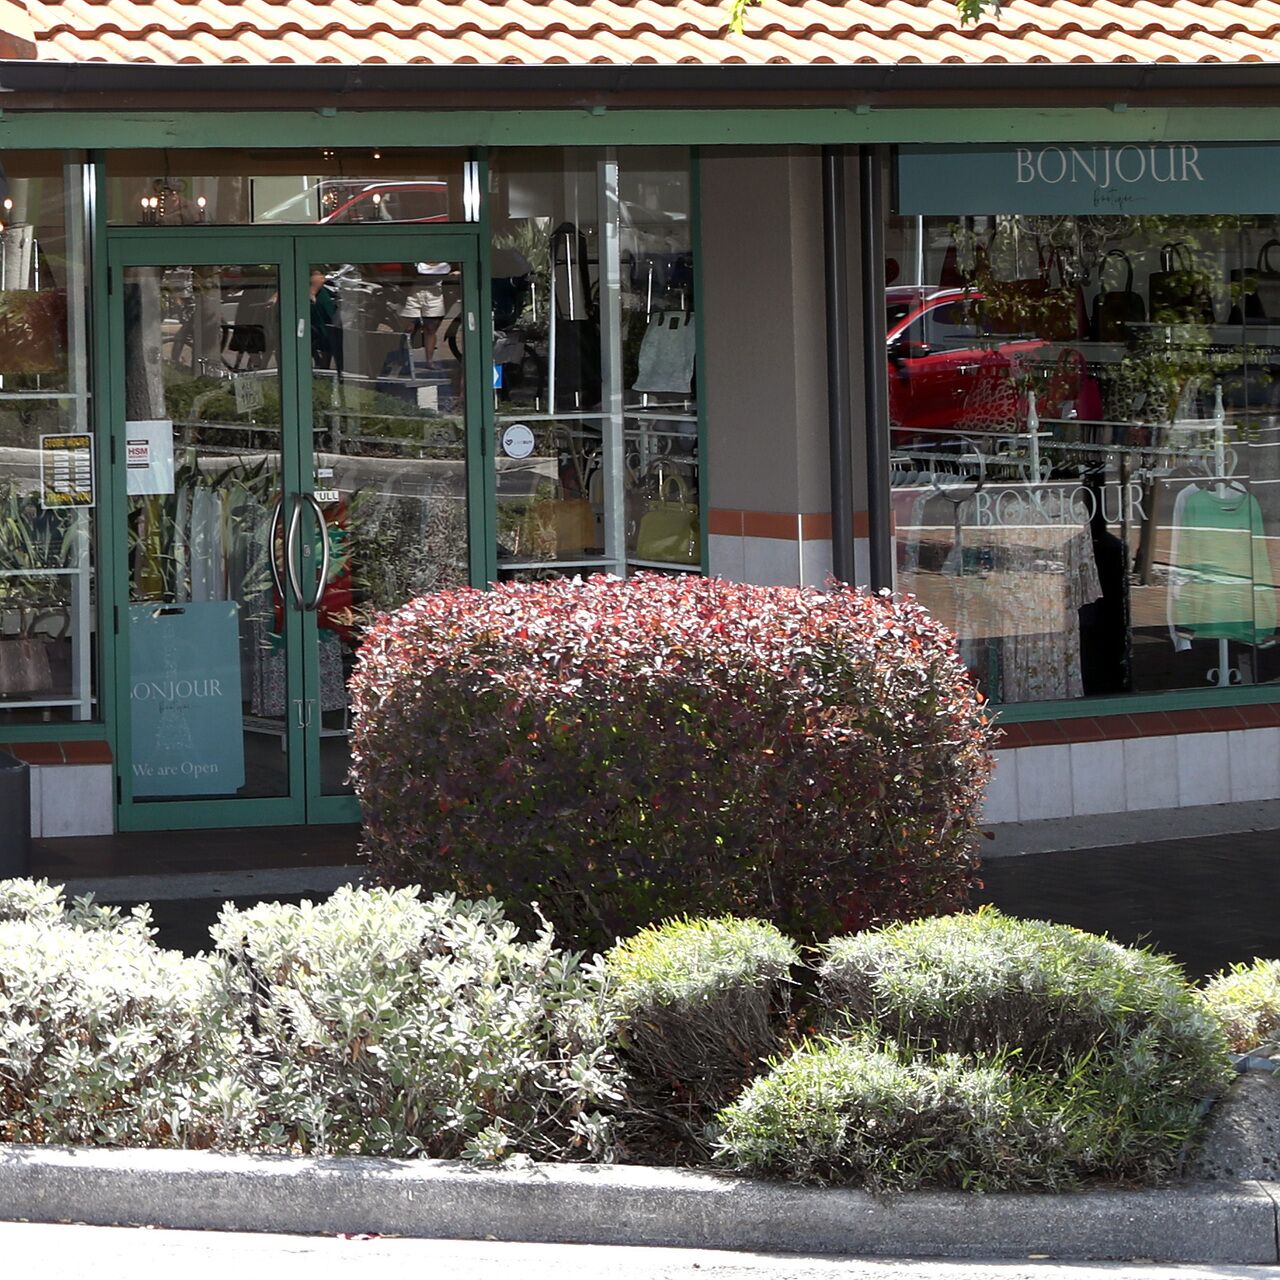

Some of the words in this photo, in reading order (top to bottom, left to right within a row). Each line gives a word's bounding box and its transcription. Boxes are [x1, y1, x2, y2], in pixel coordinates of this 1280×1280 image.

[1016, 144, 1205, 189] BONJOUR
[128, 447, 148, 455] HSM
[975, 484, 1149, 526] BONJOUR
[132, 764, 154, 776] We
[157, 765, 178, 776] are
[180, 761, 219, 779] Open
